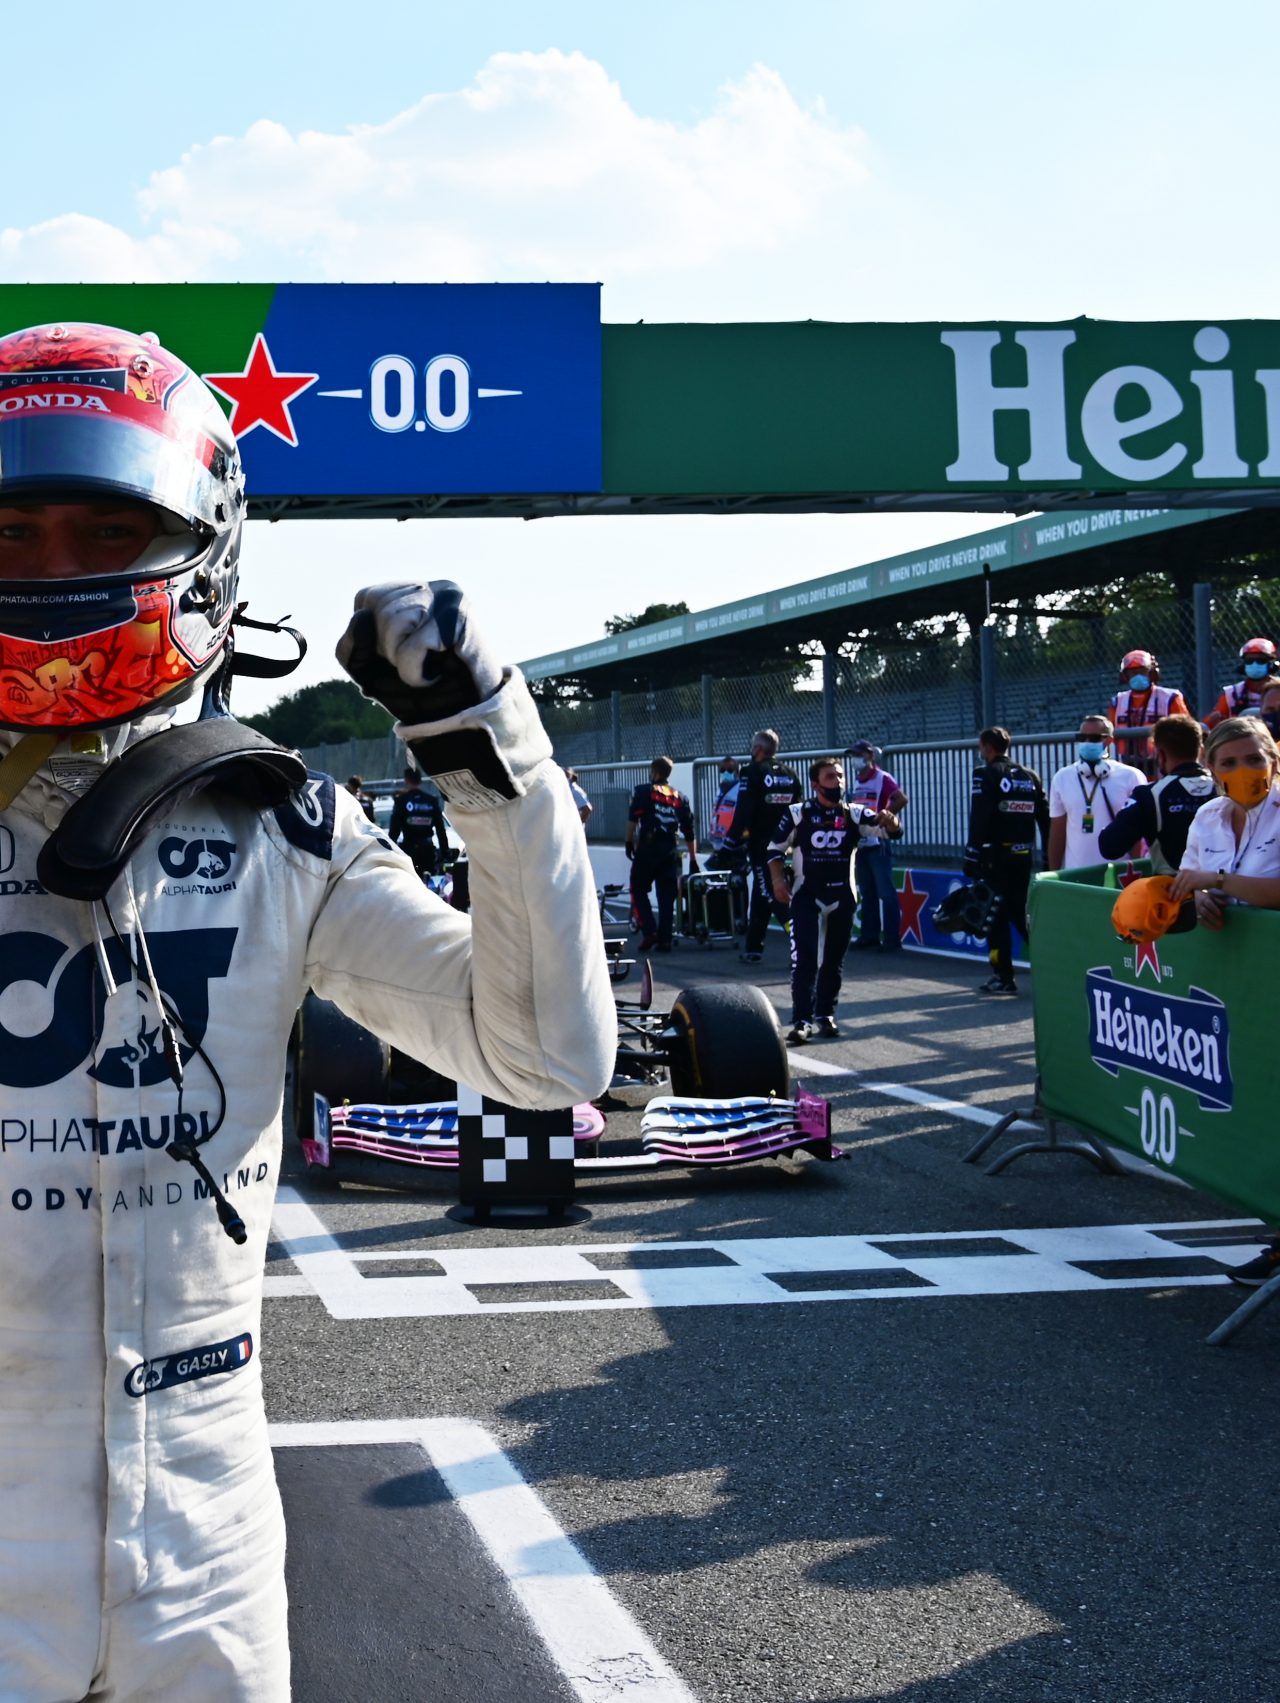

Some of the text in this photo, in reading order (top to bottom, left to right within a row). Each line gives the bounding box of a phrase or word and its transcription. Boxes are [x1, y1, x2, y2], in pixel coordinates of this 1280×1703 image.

[369, 354, 471, 433] 0.0
[1036, 523, 1065, 545] WHEN
[1066, 517, 1089, 537] YOU
[1090, 509, 1121, 531] DRIVE
[889, 540, 1007, 583] WHEN YOU DRIVE NEVER DRINK
[161, 880, 237, 896] ALPHATAURI
[1092, 988, 1223, 1084] Heineken
[1139, 1086, 1178, 1165] 0.0
[177, 1348, 228, 1376] GASLY
